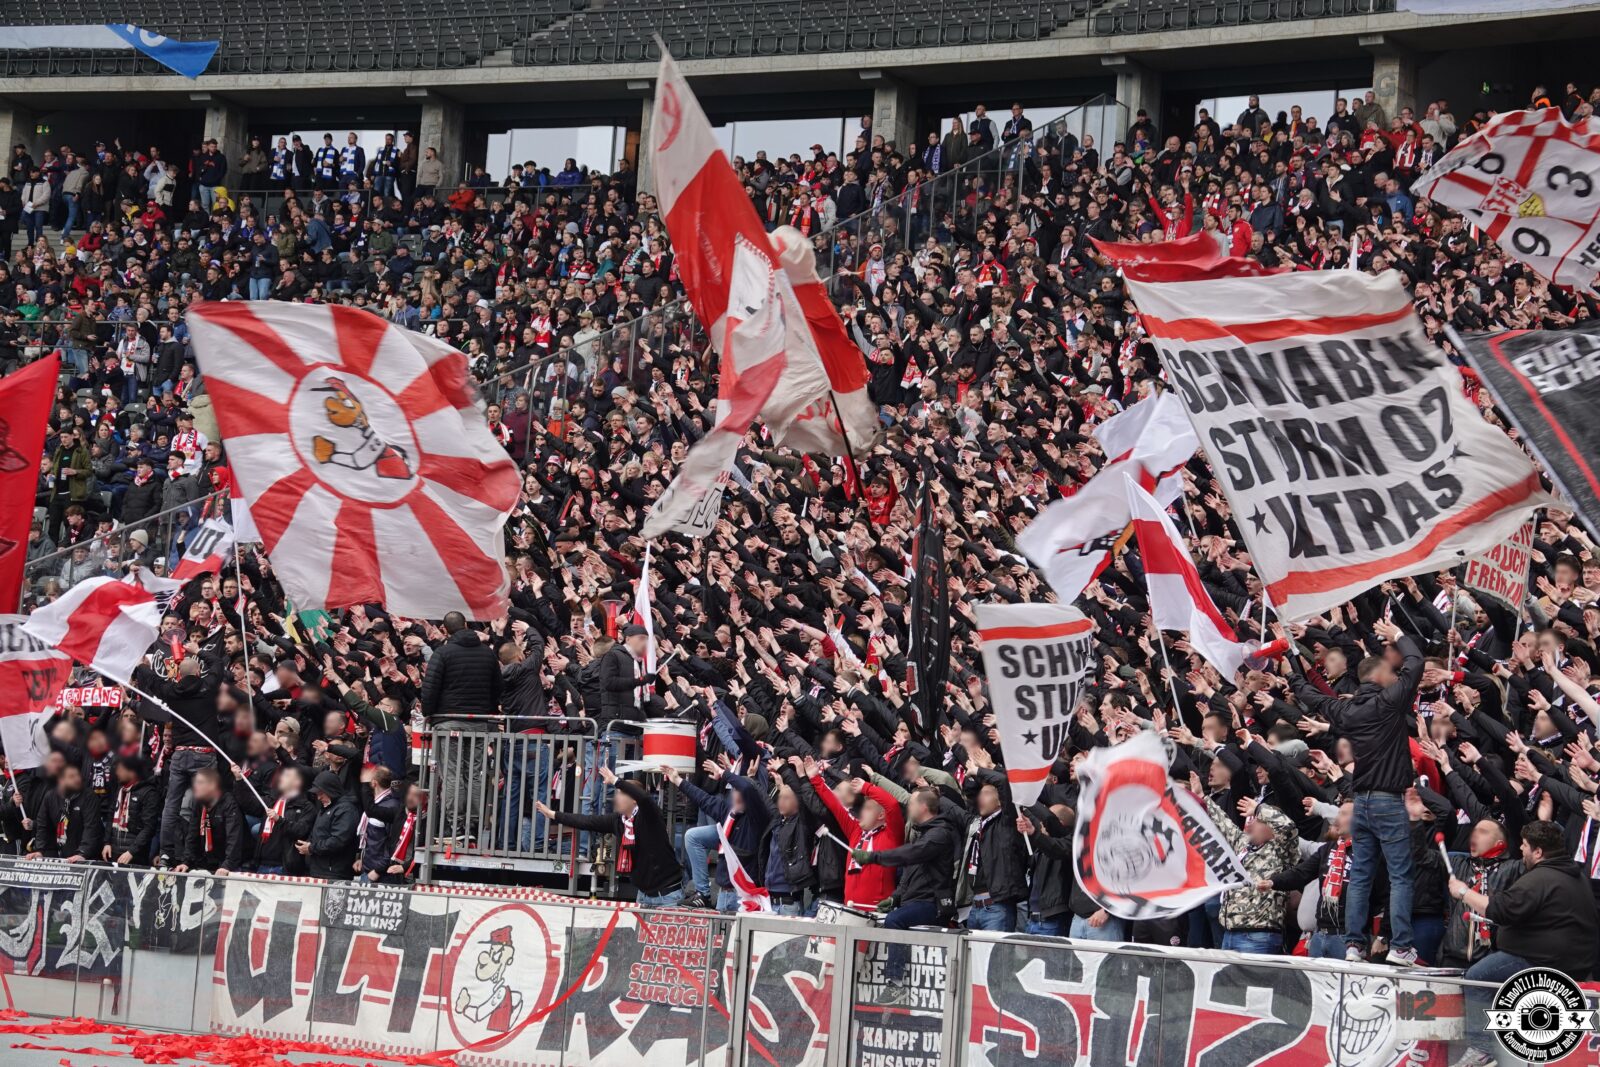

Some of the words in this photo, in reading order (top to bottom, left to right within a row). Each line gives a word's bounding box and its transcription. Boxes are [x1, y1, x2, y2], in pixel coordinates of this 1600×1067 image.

[347, 896, 403, 918] IMMER
[344, 914, 366, 926] BEI
[370, 916, 403, 931] UNS!
[862, 1026, 919, 1051] KAMPF
